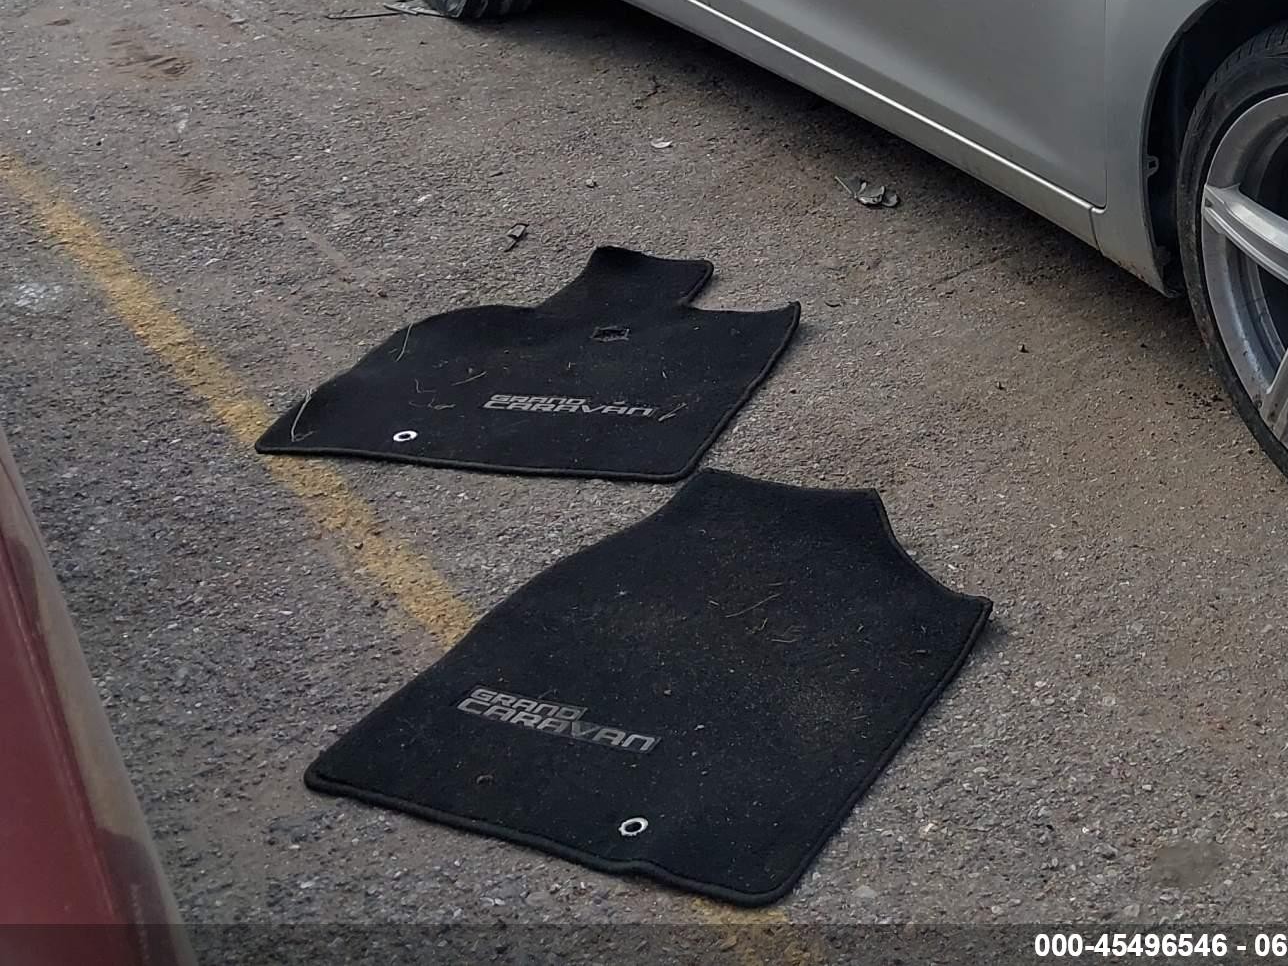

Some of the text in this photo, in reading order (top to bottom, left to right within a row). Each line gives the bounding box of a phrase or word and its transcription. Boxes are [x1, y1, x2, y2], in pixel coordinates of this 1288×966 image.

[483, 400, 653, 416] CARAVAN
[490, 394, 587, 405] GRAND
[470, 688, 583, 721] GRAND
[456, 698, 657, 752] CARAVAN
